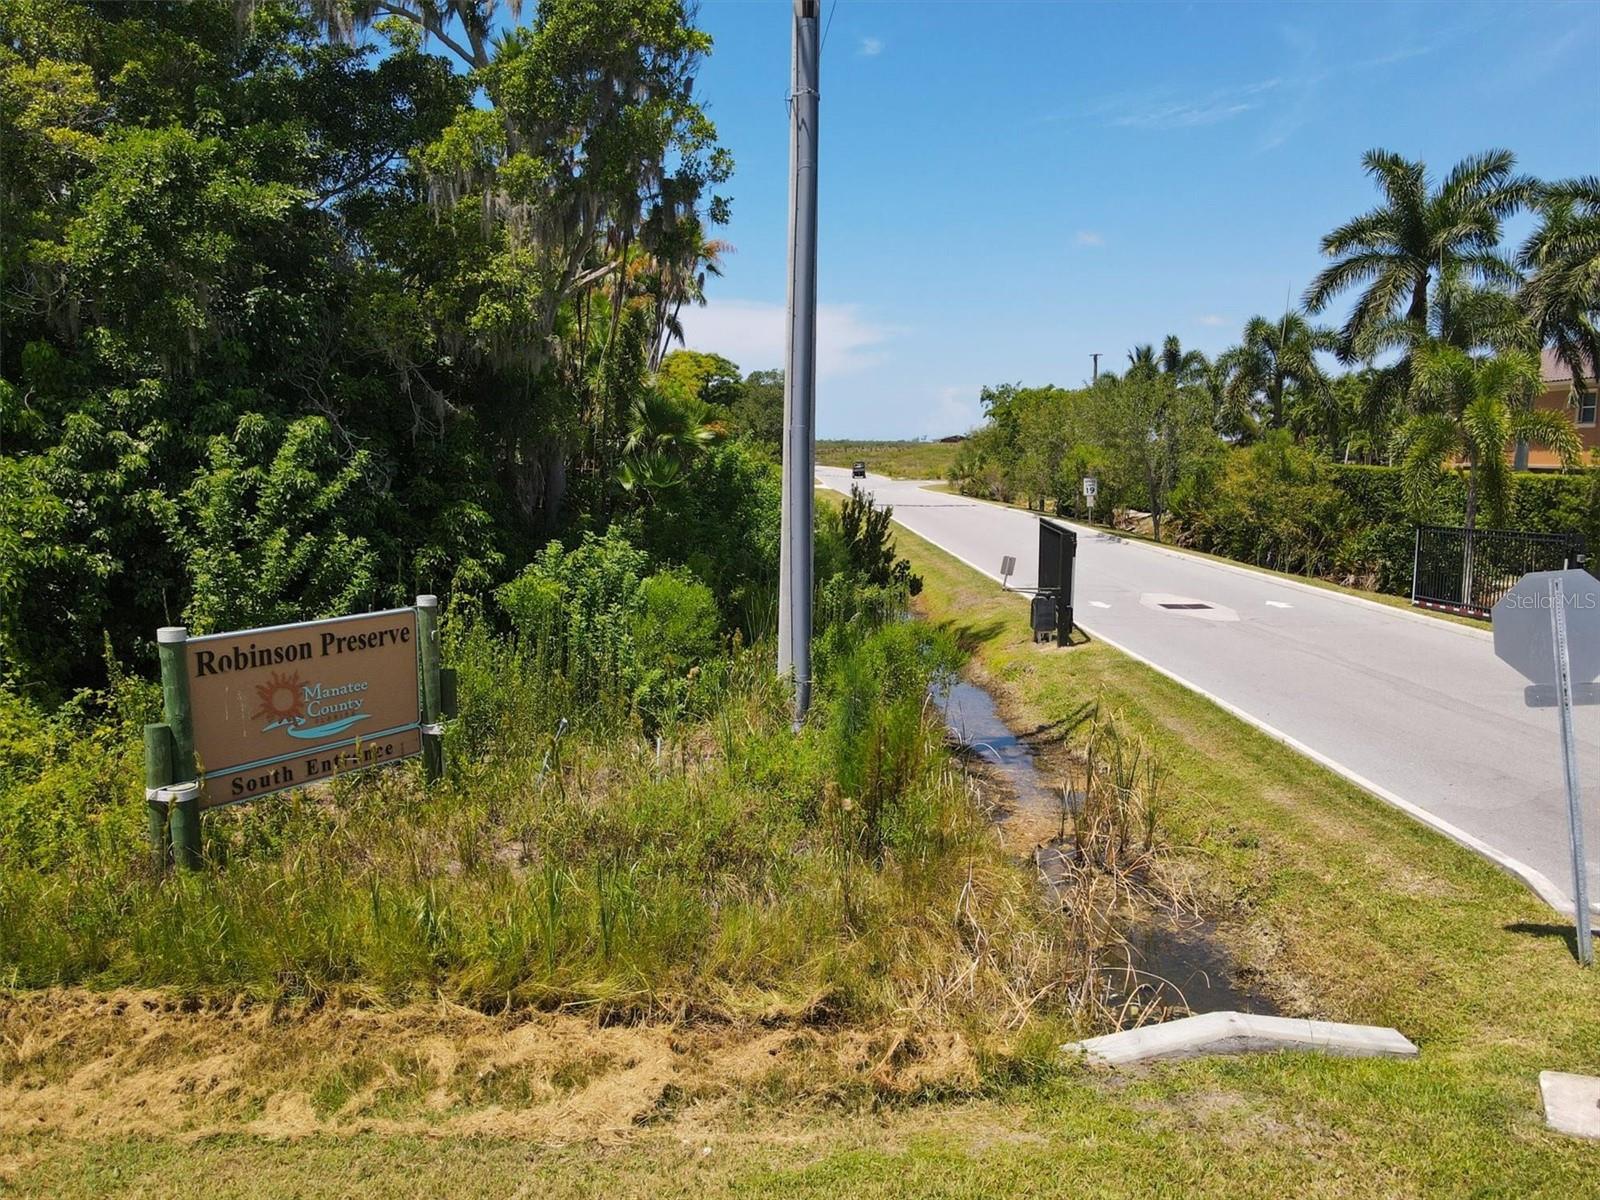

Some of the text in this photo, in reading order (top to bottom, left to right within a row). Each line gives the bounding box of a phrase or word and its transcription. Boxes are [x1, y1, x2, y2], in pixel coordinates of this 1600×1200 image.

[194, 626, 410, 678] Robinson Preserve
[302, 681, 368, 701] Manatee
[307, 698, 364, 717] County
[231, 766, 294, 796] South
